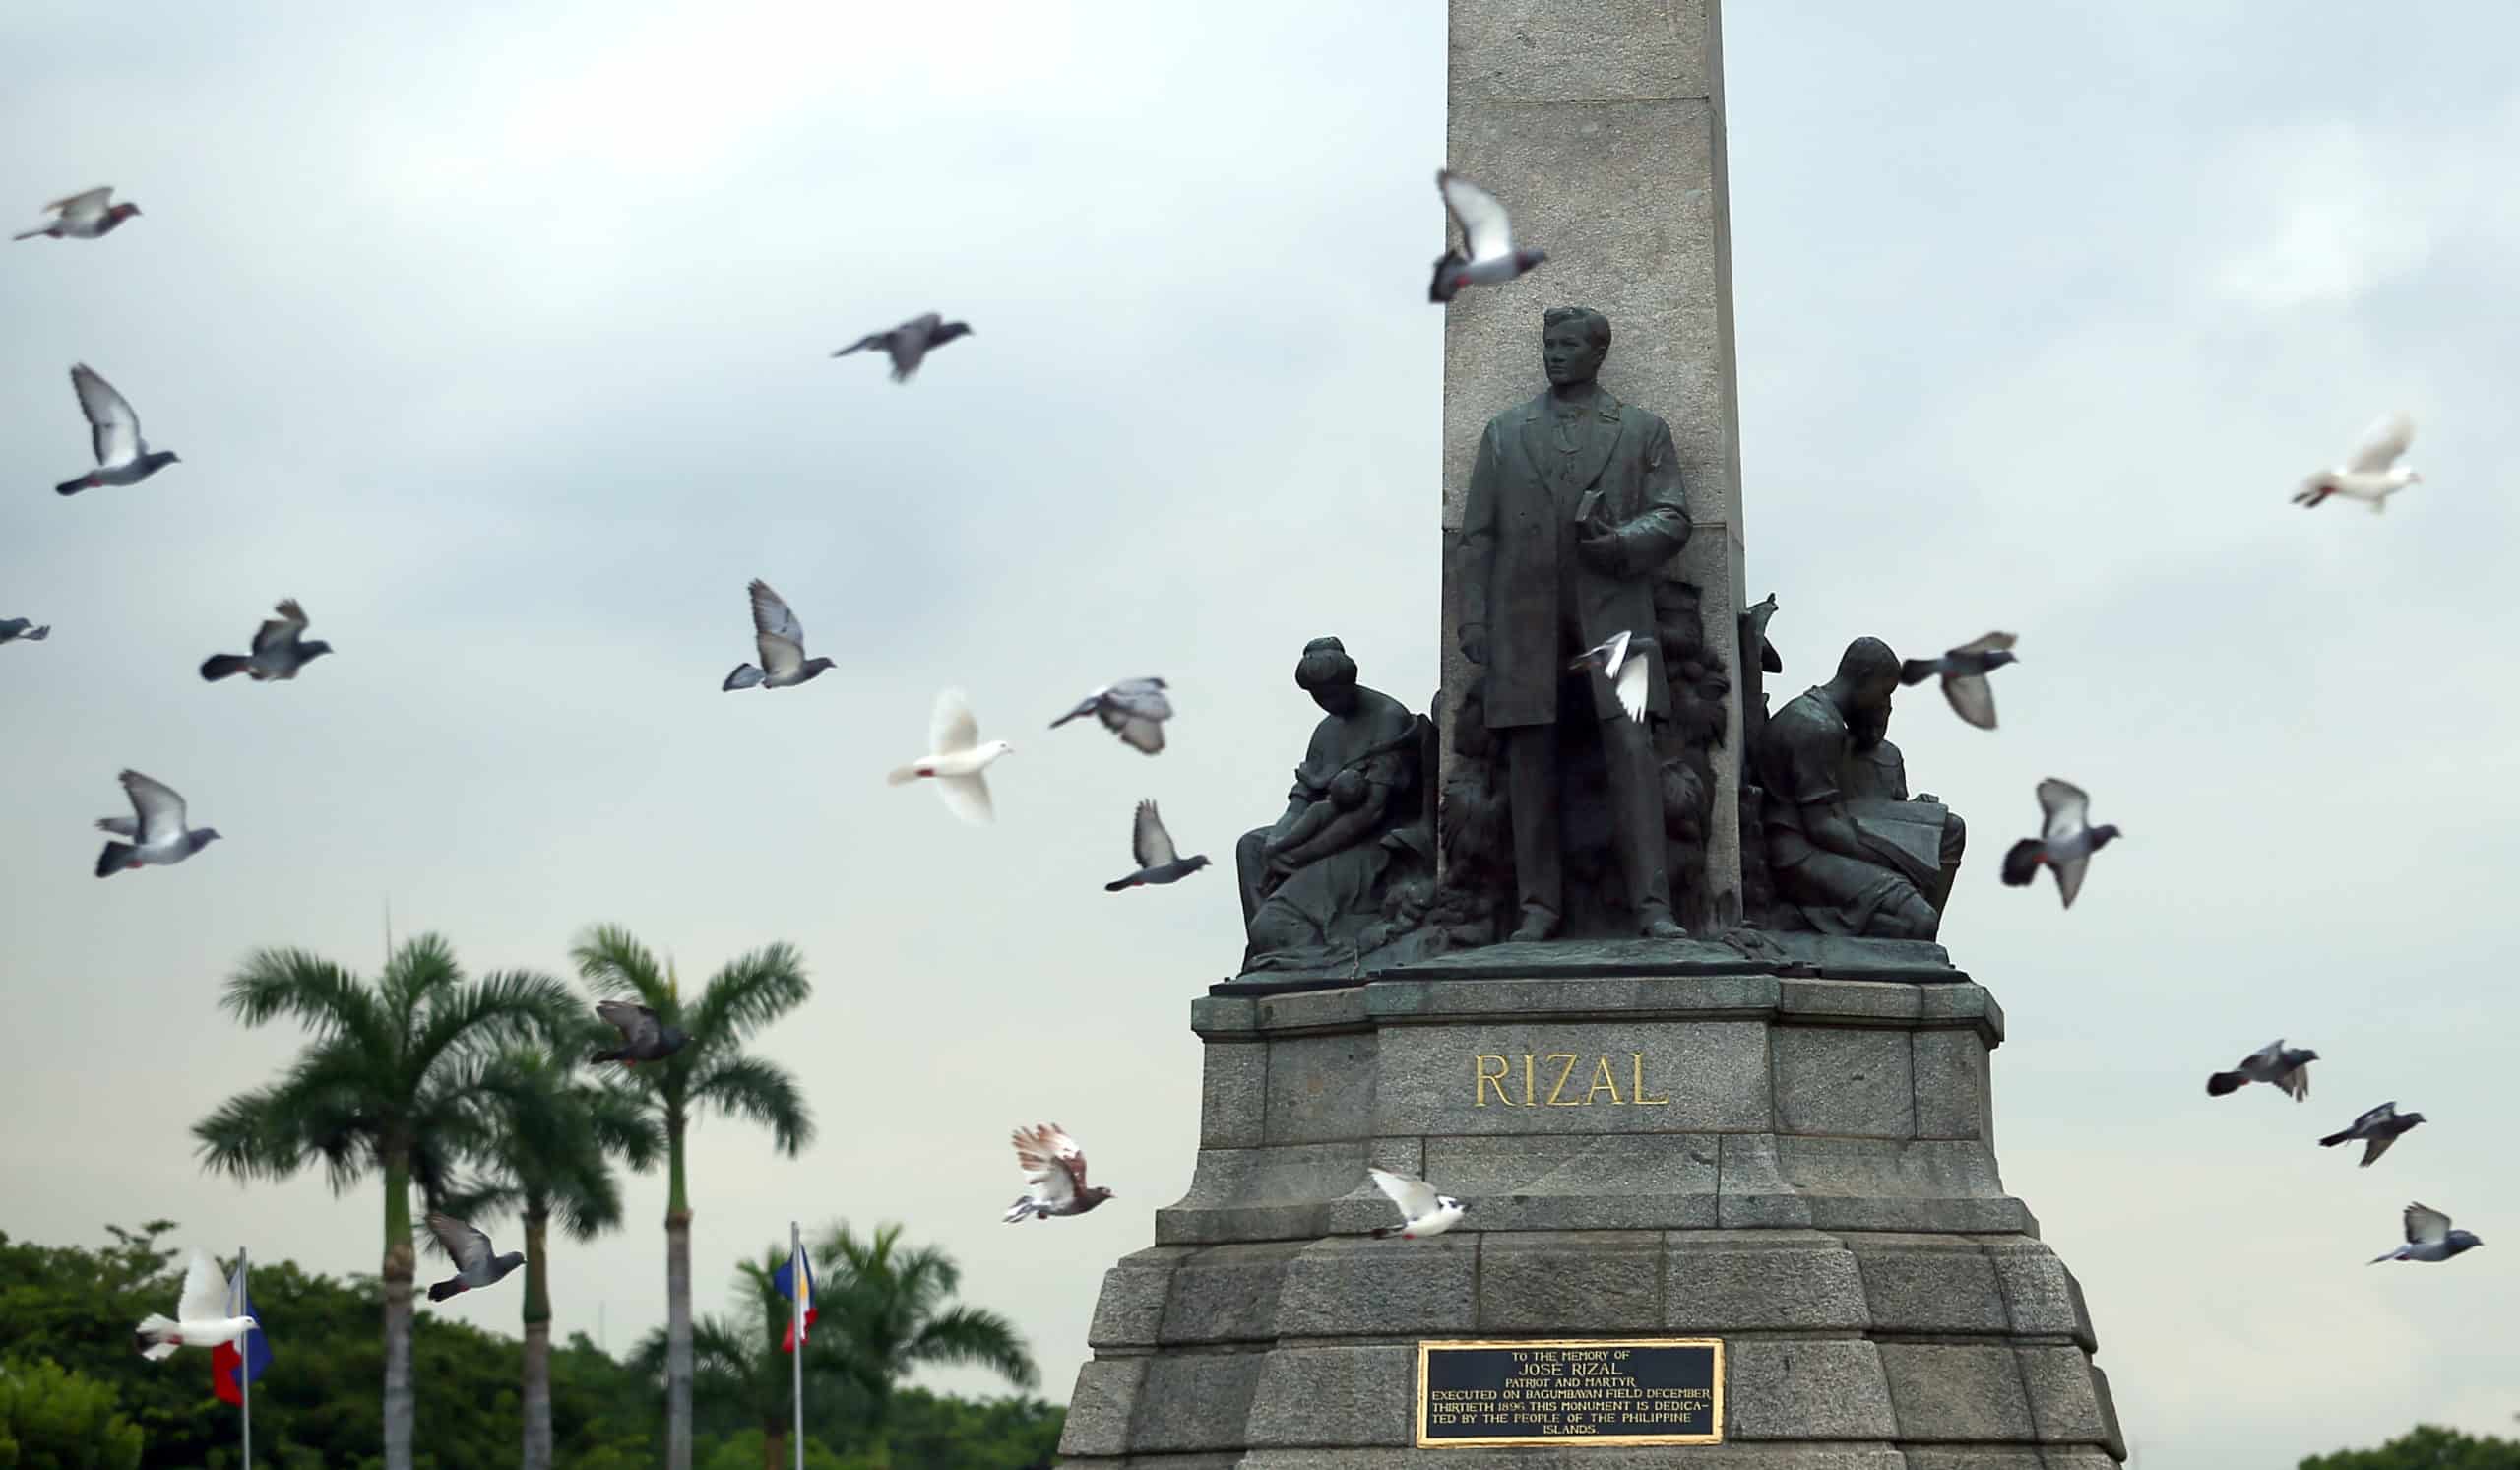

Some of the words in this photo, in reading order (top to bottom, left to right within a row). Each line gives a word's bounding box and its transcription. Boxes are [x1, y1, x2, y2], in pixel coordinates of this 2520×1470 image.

[1474, 1051, 1670, 1107] RIZAL
[1512, 1352, 1528, 1362] TO
[1535, 1352, 1557, 1362] THE
[1562, 1351, 1608, 1362] MEMORY
[1614, 1350, 1630, 1360] OF
[1572, 1363, 1622, 1377] RIZAL
[1505, 1378, 1550, 1388] PATRIOT
[1555, 1378, 1581, 1388] AND
[1585, 1377, 1636, 1387] MARTYR
[1432, 1390, 1497, 1400] EXECUTED
[1503, 1390, 1520, 1399] ON
[1526, 1389, 1602, 1399] BAGUMBAYAN
[1606, 1389, 1643, 1398] FIELD
[1432, 1402, 1494, 1413] THIRTIETH
[1530, 1402, 1556, 1412] THIS
[1561, 1401, 1630, 1411] MONUMENT
[1637, 1401, 1649, 1411] IS
[1655, 1401, 1709, 1411] DEDICA-
[1432, 1414, 1456, 1424] TED
[1462, 1414, 1477, 1424] BY
[1483, 1414, 1508, 1424] THE
[1514, 1414, 1560, 1424] PEOPLE
[1567, 1413, 1583, 1423] OF
[1590, 1413, 1615, 1423] THE
[1622, 1413, 1691, 1423] PHILIPPINE
